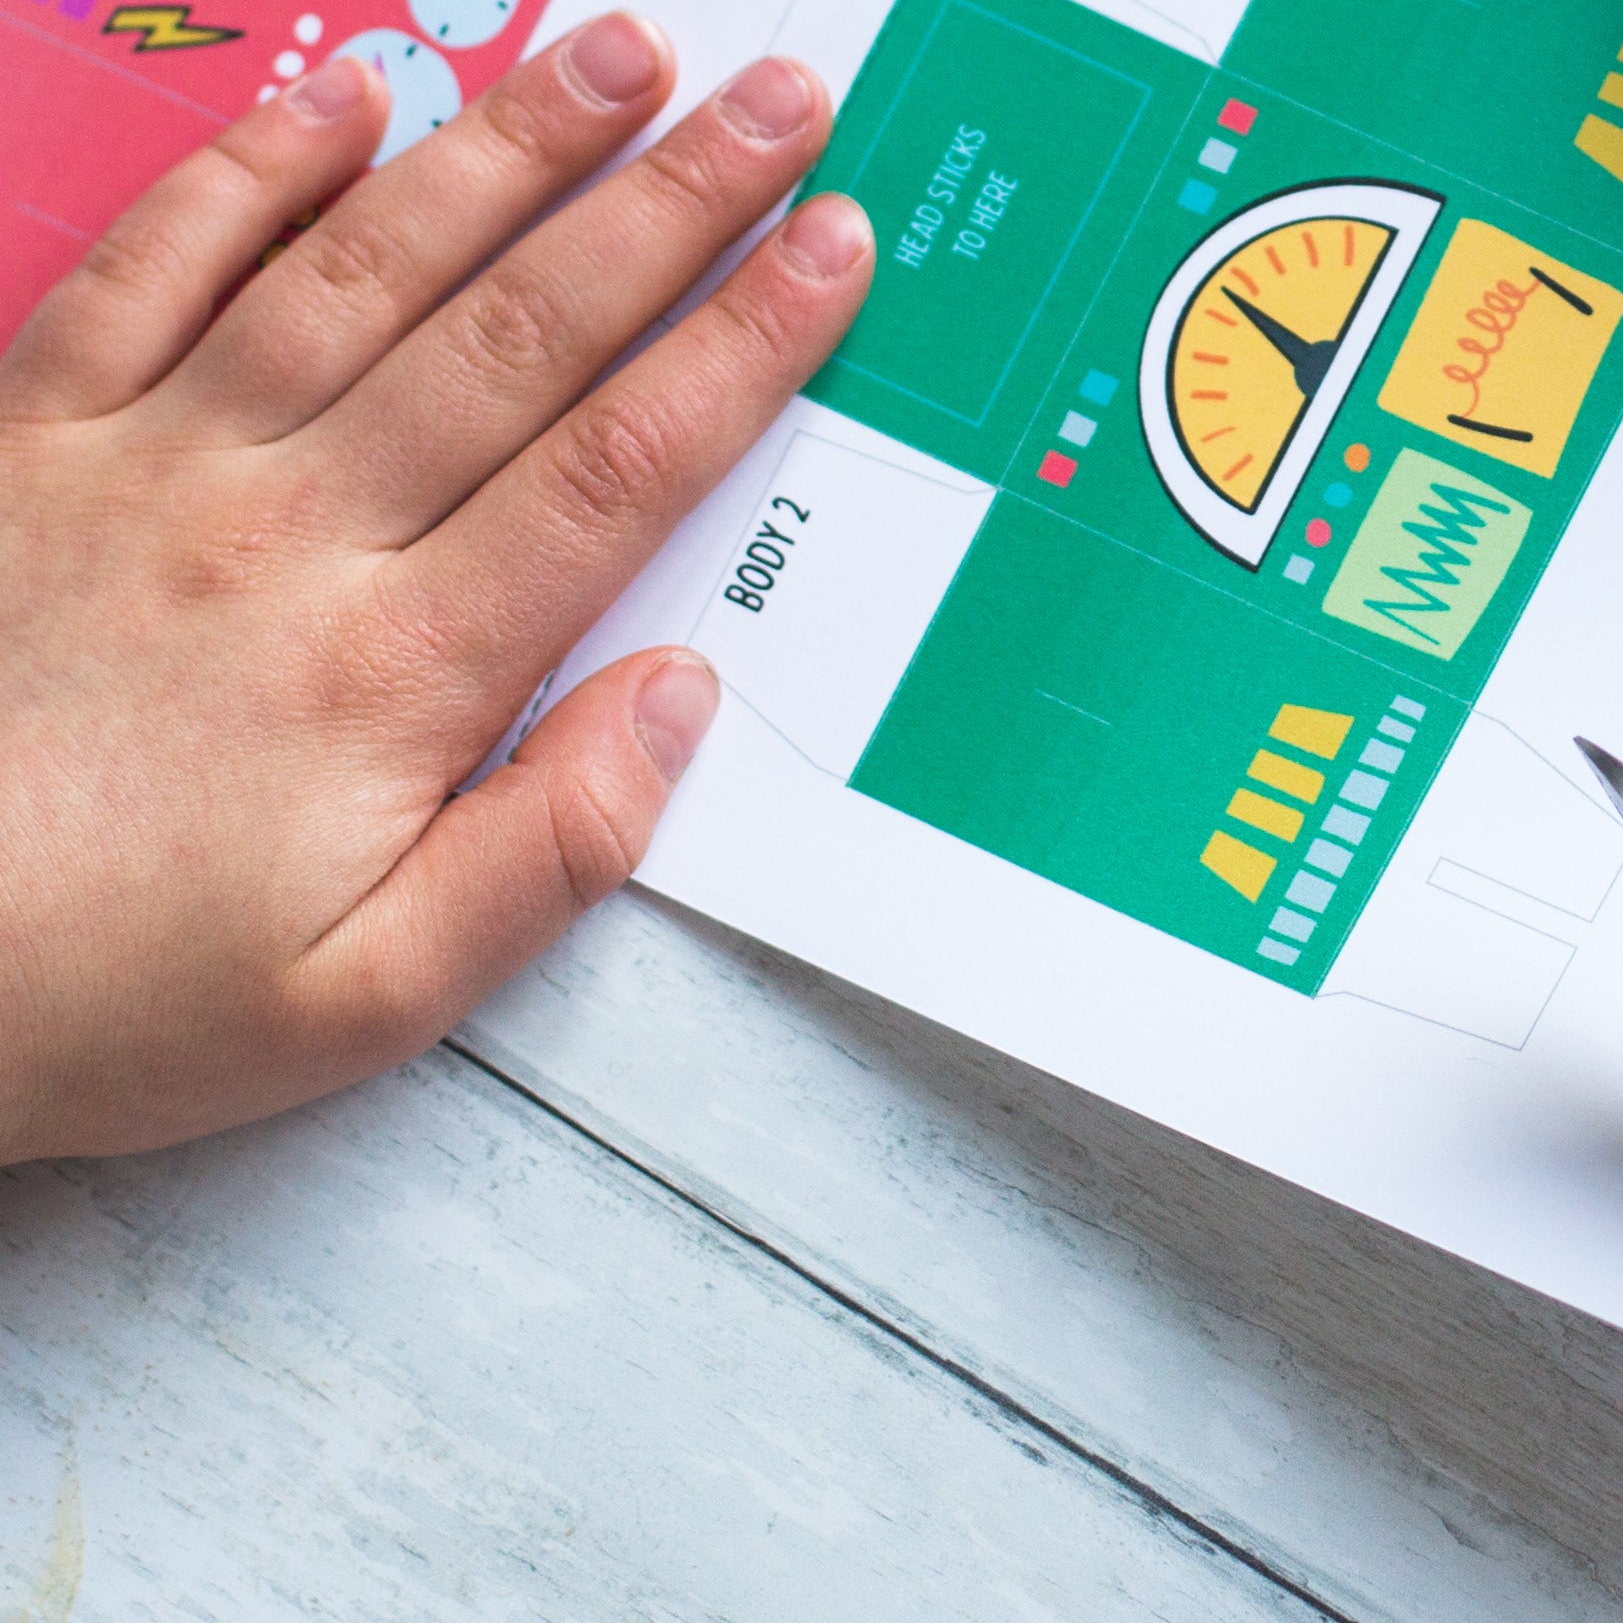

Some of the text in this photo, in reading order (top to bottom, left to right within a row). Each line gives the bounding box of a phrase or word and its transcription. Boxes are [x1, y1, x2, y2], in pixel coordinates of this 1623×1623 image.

[895, 124, 986, 268] HEAD STICKS
[952, 170, 1018, 259] TO HERE
[724, 496, 811, 613] BODY 2
